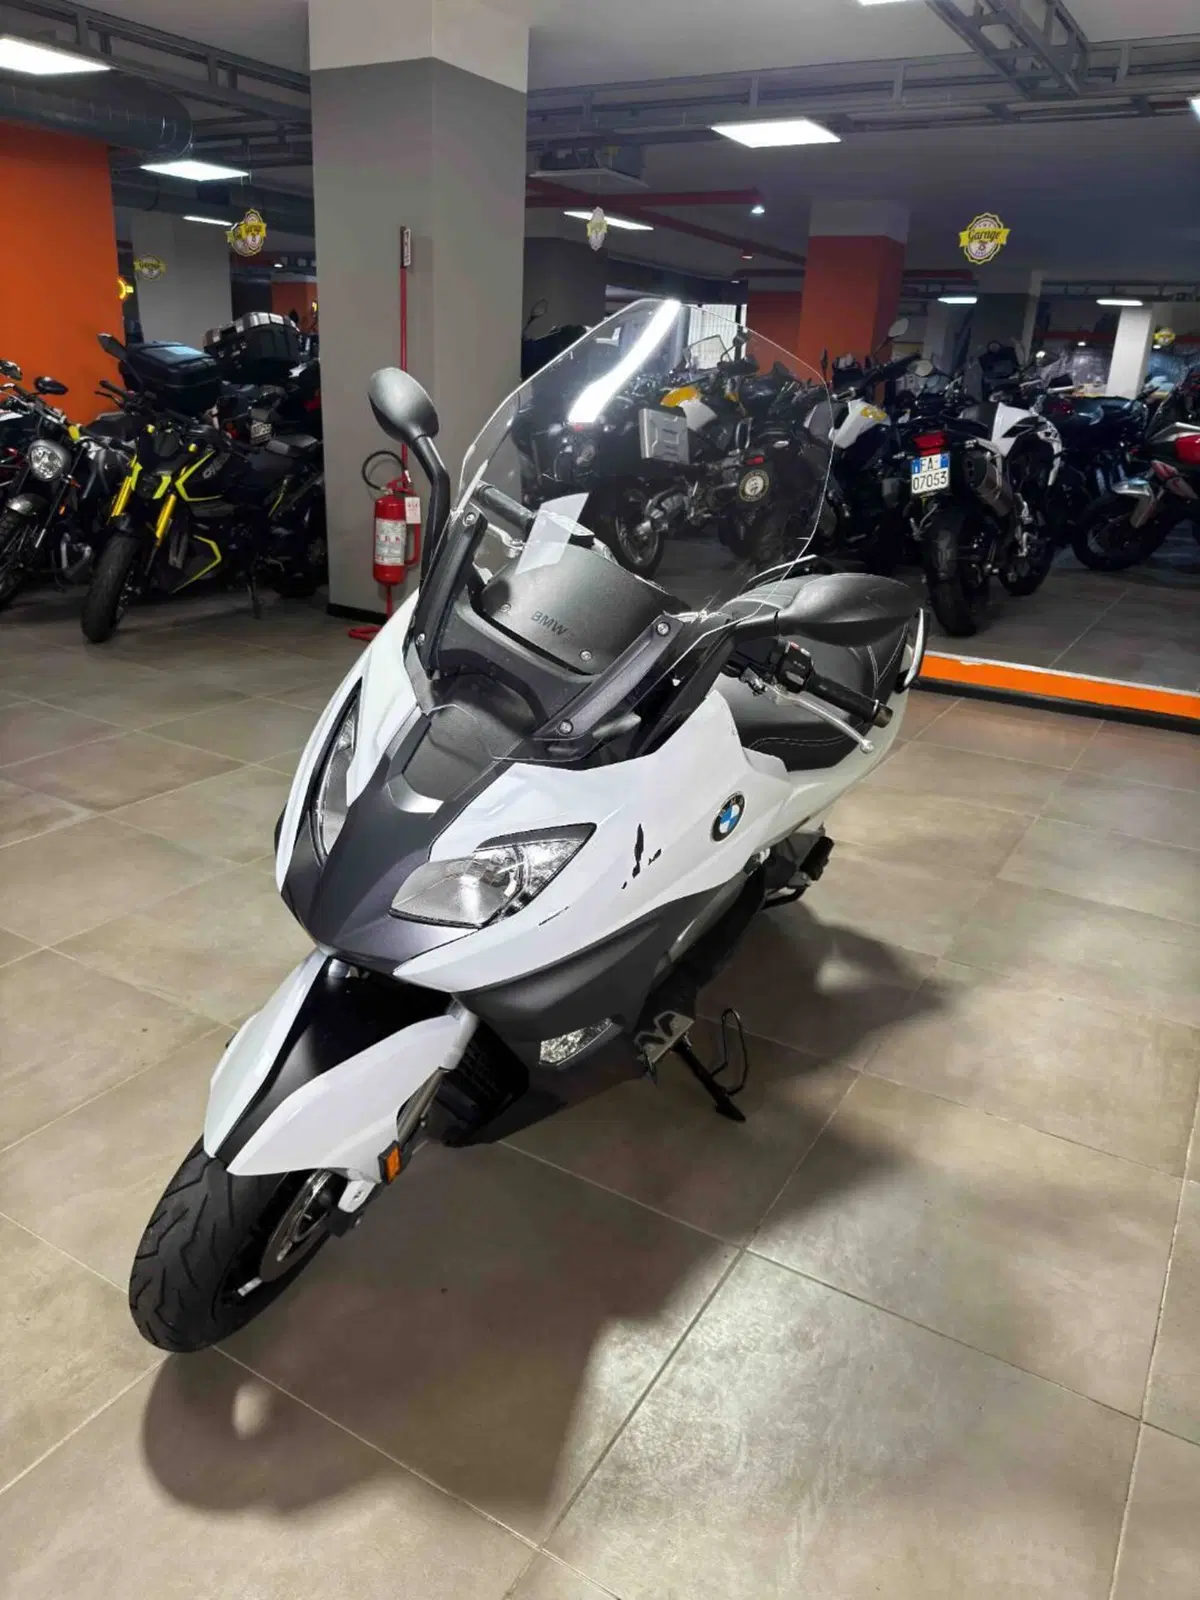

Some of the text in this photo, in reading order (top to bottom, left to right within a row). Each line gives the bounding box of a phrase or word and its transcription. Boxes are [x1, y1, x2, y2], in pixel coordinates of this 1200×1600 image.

[968, 229, 1001, 243] Garage
[912, 471, 948, 491] 07053
[531, 610, 569, 636] BMW
